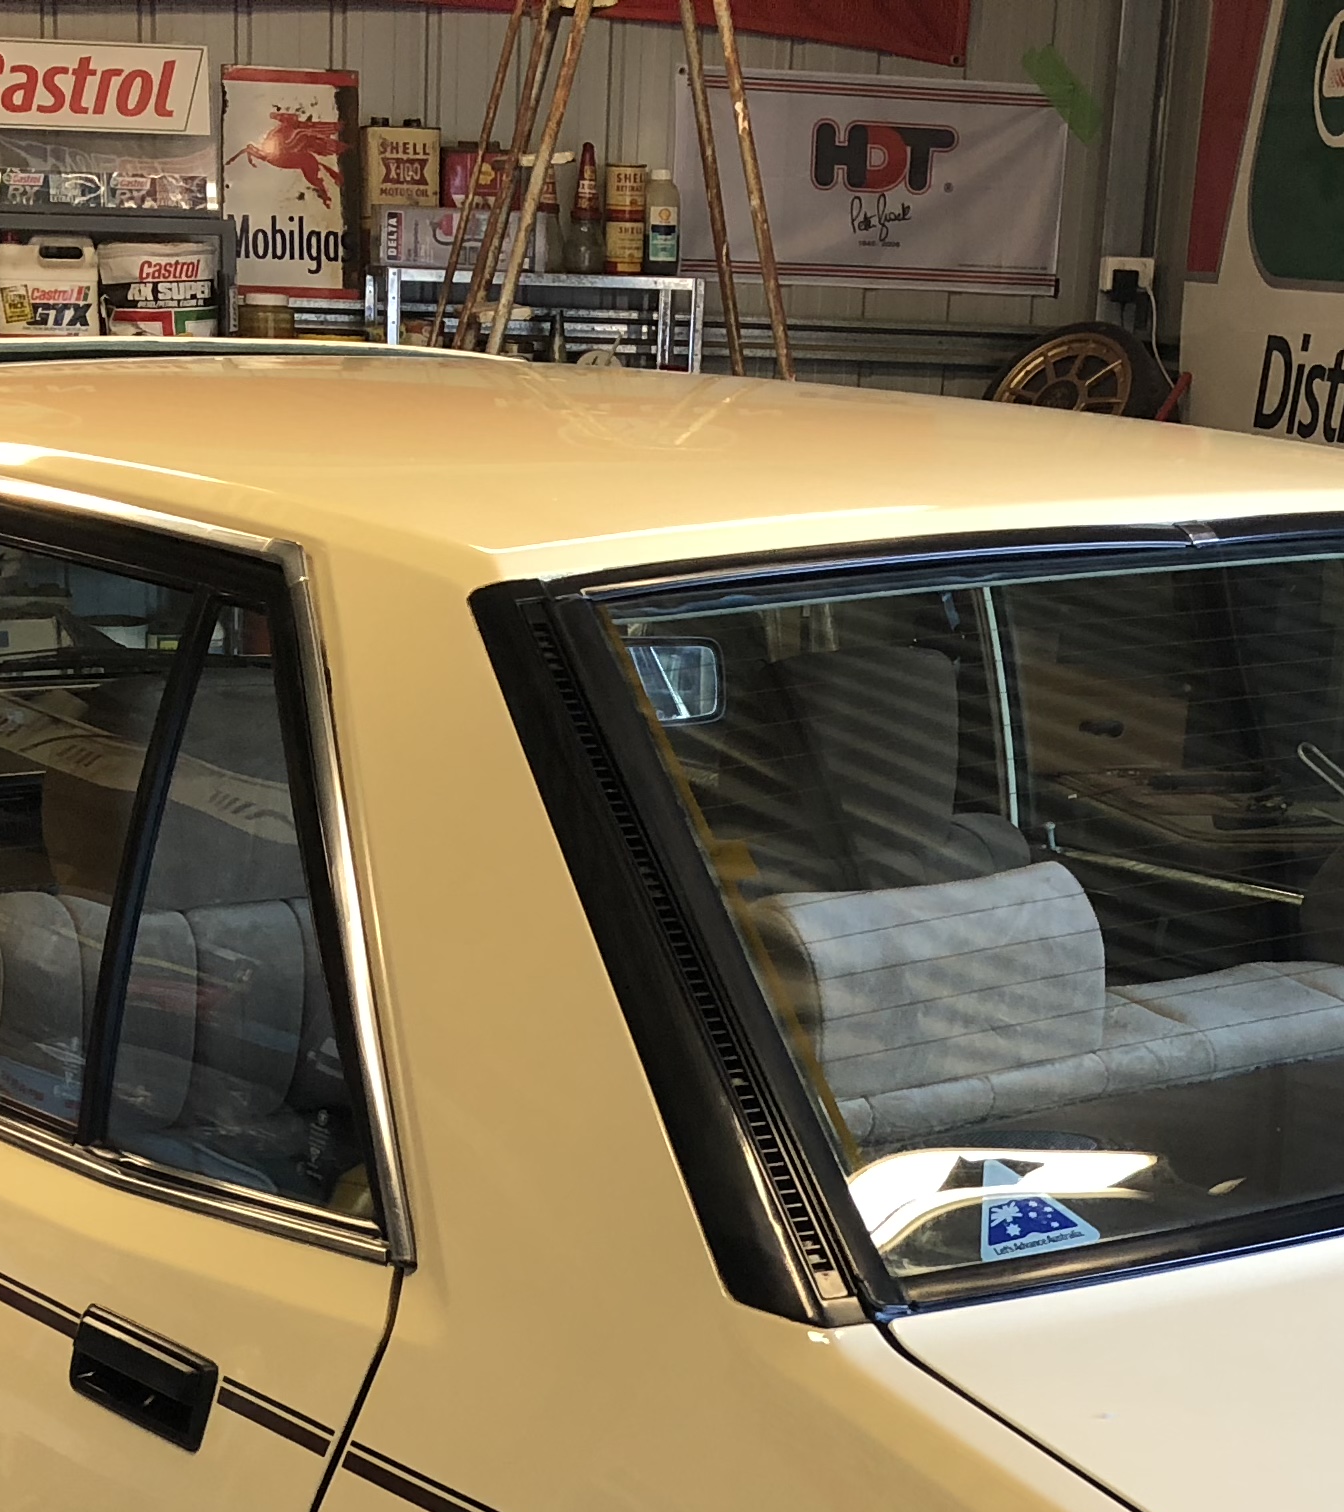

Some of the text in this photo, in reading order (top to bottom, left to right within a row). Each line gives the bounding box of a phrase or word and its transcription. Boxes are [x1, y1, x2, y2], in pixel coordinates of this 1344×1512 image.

[380, 141, 430, 156] SHELL
[811, 118, 959, 195] HDT
[12, 174, 42, 184] Castrol
[617, 172, 643, 184] SHEL
[416, 188, 430, 198] OIL
[387, 217, 398, 256] DELTA
[138, 259, 201, 282] Castrol
[31, 287, 74, 301] Castrol
[26, 303, 92, 327] GTX
